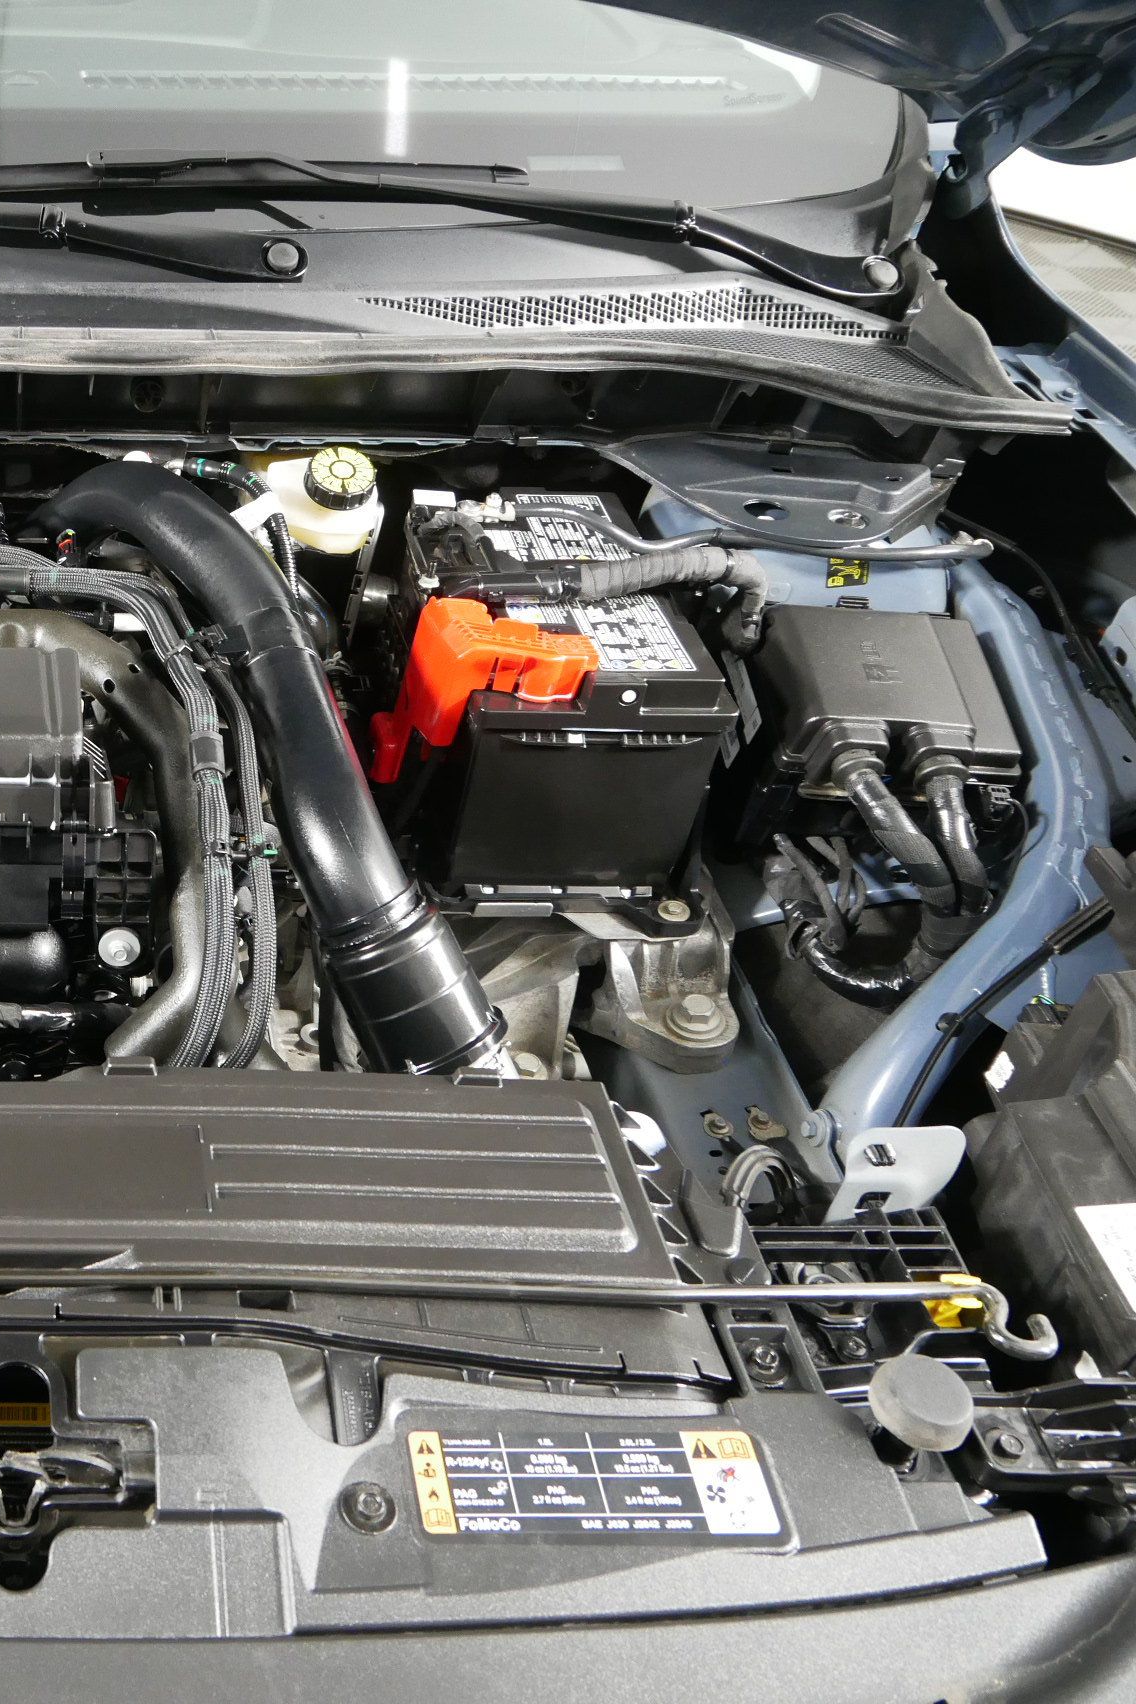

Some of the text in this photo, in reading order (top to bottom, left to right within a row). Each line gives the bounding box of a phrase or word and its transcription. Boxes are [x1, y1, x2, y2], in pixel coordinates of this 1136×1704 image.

[444, 1456, 489, 1469] R-1234yf
[453, 1488, 478, 1499] PAG
[458, 1517, 521, 1531] FoMoCo
